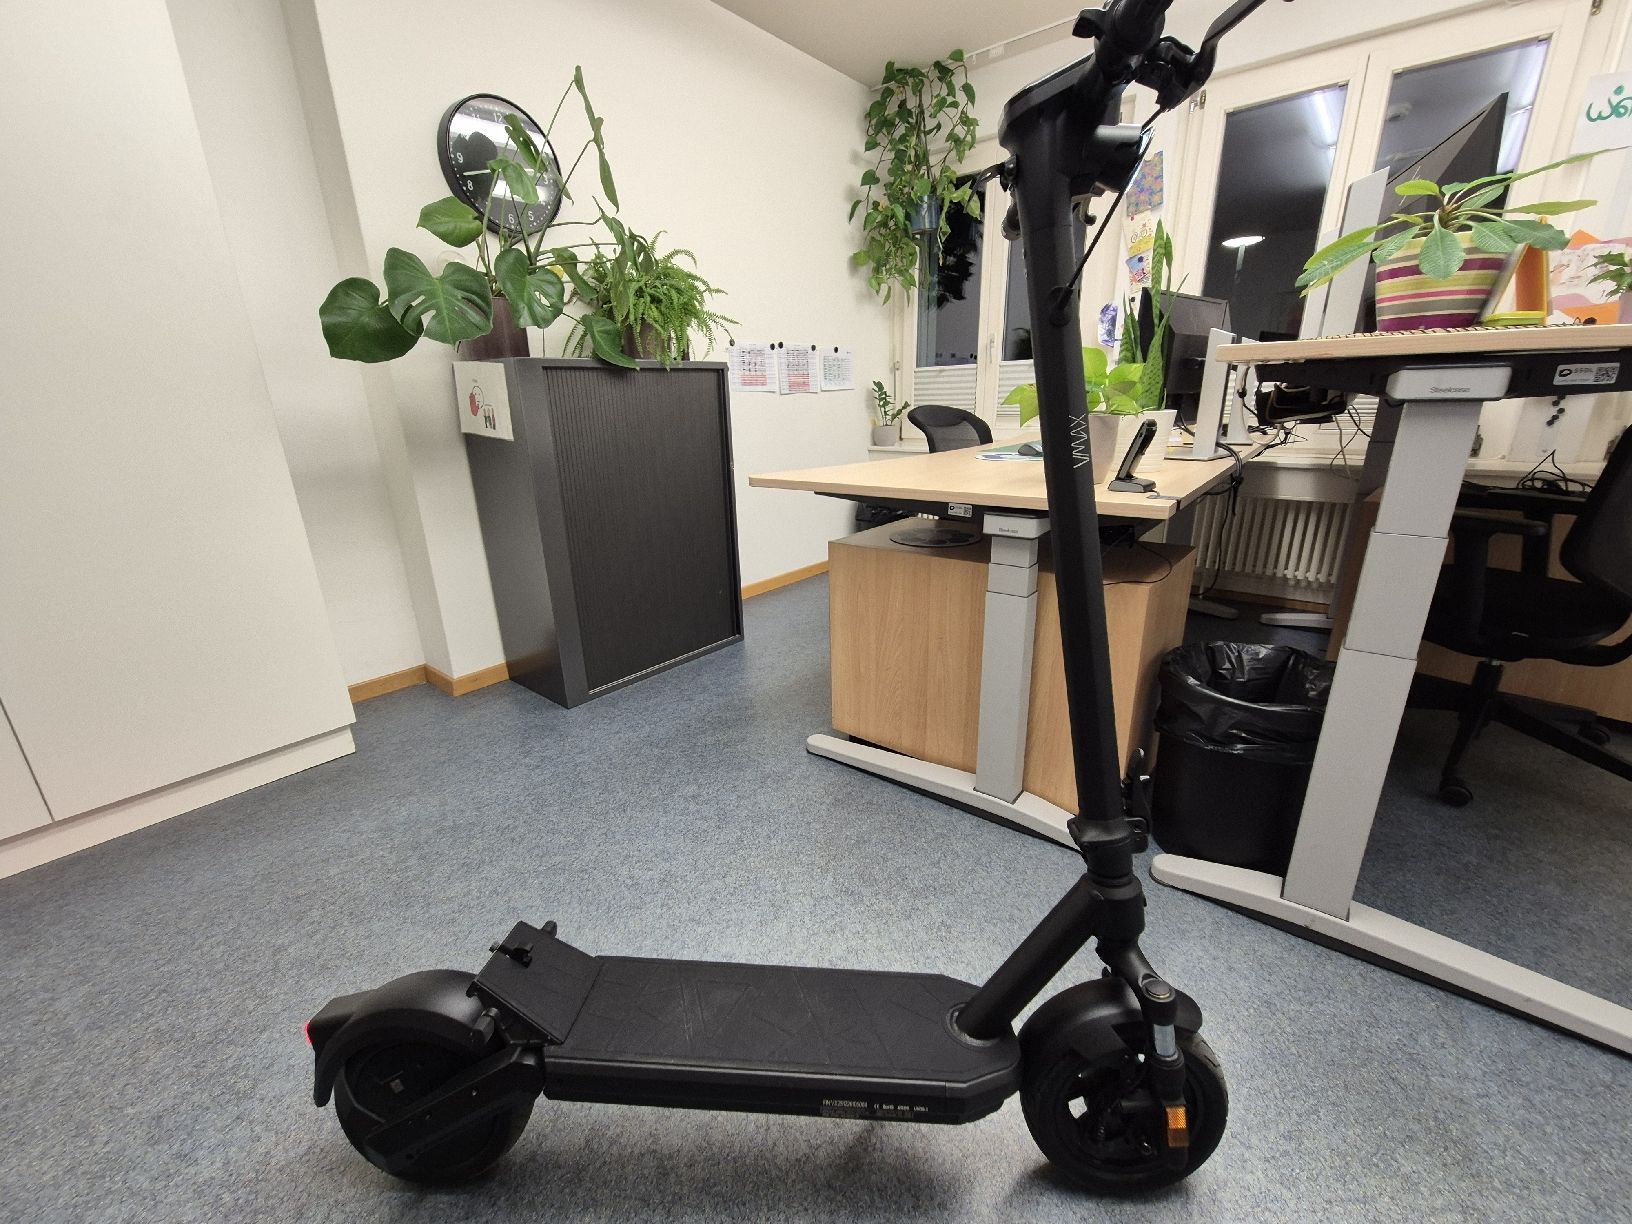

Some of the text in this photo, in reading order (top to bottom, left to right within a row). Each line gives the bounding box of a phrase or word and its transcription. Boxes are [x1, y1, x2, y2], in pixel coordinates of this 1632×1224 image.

[493, 112, 503, 124] 12
[456, 152, 464, 163] 9
[467, 180, 474, 191] 8
[508, 213, 515, 224] 6
[528, 210, 535, 221] 5
